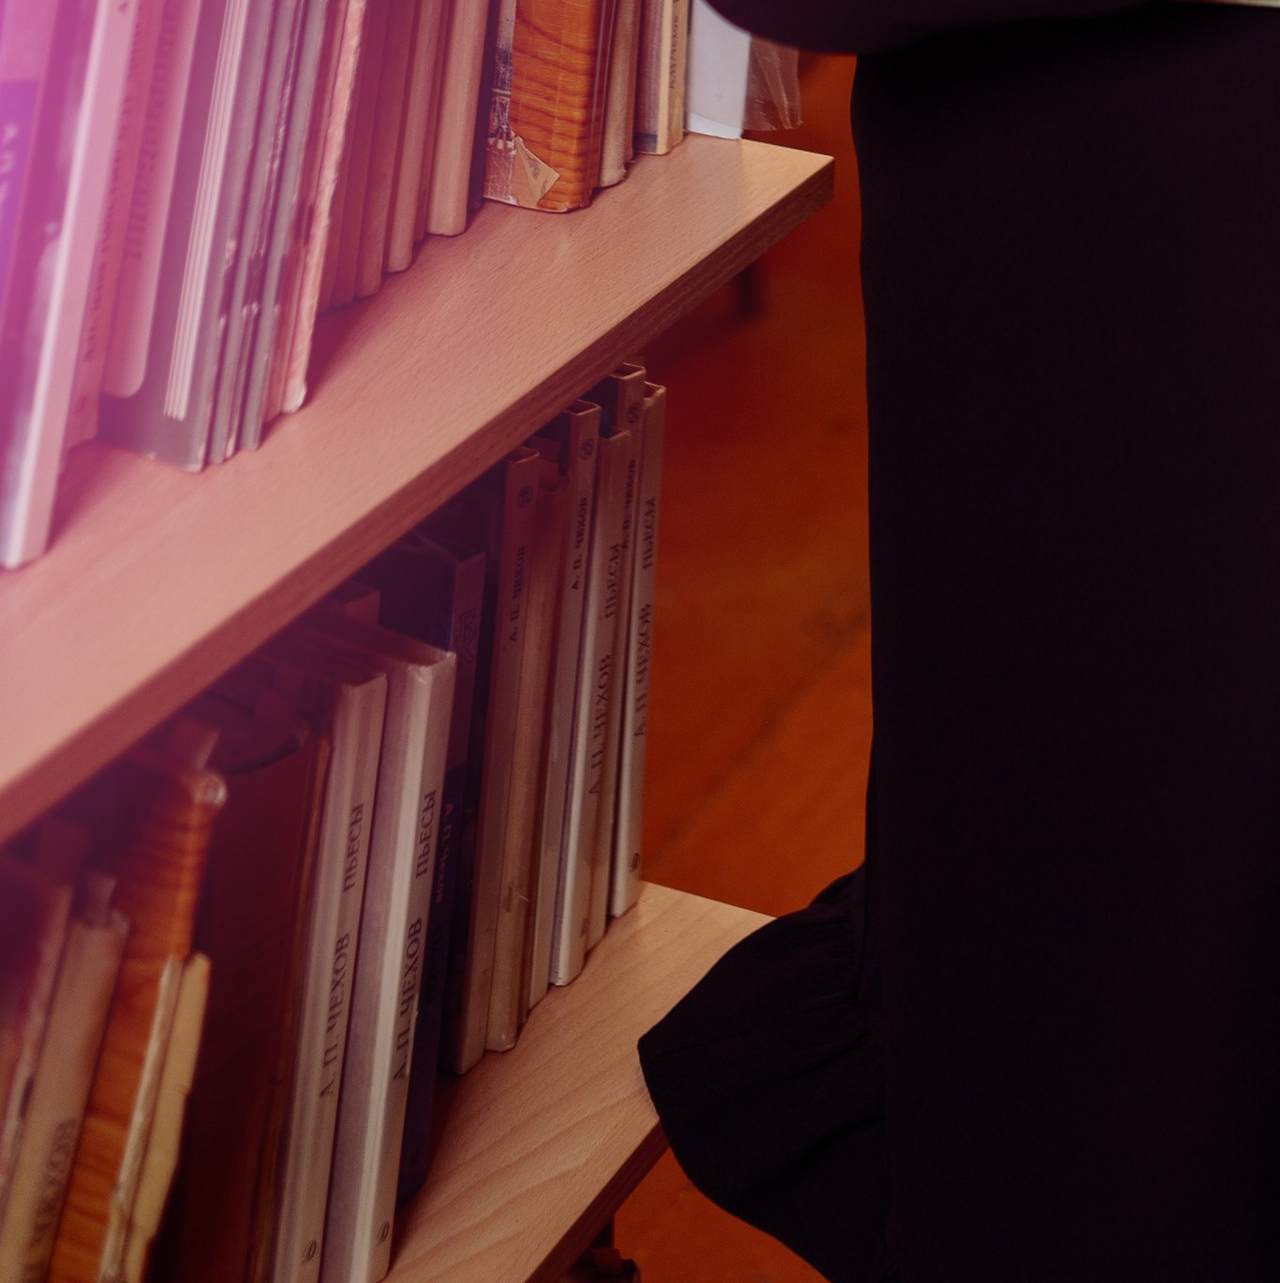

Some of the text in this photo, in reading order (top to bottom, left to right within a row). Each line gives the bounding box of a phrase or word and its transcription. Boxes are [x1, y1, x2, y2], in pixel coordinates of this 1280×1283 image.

[574, 497, 588, 550] ЧЕХОВ
[641, 497, 657, 571] ПЬЕСЫ
[512, 546, 526, 600] ЧЕХОВ
[593, 654, 611, 739] ЧЕХОВ
[603, 542, 620, 619] ПЬЕСЫ
[635, 603, 653, 685] ЧЕХОВ
[324, 932, 351, 1035] ЧЕХОВ
[341, 803, 364, 895] ПЬЕСЫ
[398, 917, 423, 1018] ЧЕХОВ
[415, 788, 437, 880] ПЬЕСЫ
